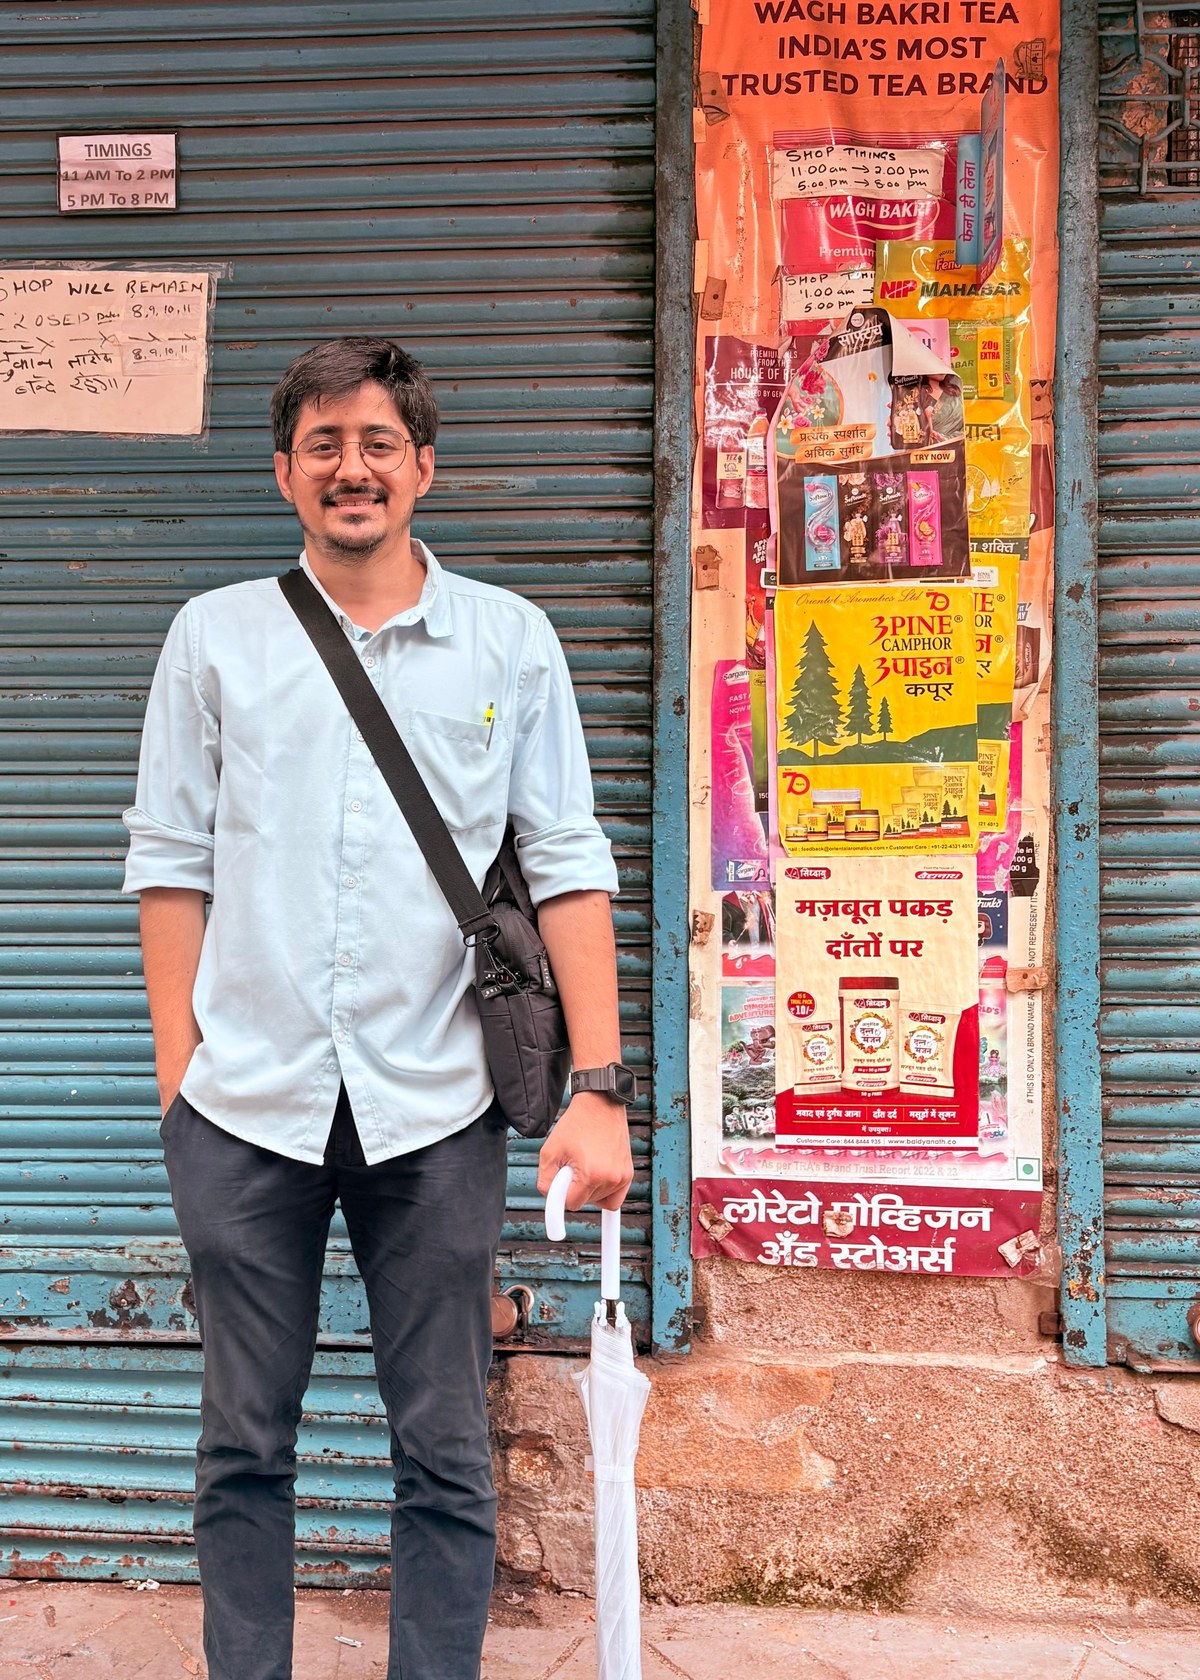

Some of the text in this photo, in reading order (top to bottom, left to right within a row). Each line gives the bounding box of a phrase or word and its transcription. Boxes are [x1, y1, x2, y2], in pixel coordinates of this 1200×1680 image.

[755, 0, 1020, 25] WAGH BAKRI TEA
[897, 36, 987, 61] MOST
[722, 69, 859, 97] TRUSTED
[868, 73, 928, 97] TEA
[84, 143, 152, 158] TIMINGS
[786, 146, 835, 162] SHOP
[62, 169, 175, 181] 11 AM To 2 PM
[875, 166, 905, 175] 2.00
[909, 167, 930, 178] pm
[830, 179, 848, 188] pm
[907, 179, 927, 190] pm
[67, 192, 169, 207] 5 PM To 8 PM
[830, 202, 875, 219] WAGH
[785, 274, 829, 286] SHOP
[68, 282, 115, 296] WILL
[126, 279, 204, 298] REMAIN
[880, 280, 1022, 299] NIP MAHABAR
[804, 300, 854, 313] 5.00 pm
[0, 312, 90, 330] LOSED
[982, 341, 998, 350] 20g
[980, 351, 1000, 360] EXTRA
[731, 367, 764, 379] HOUSE
[768, 368, 780, 379] OF
[882, 637, 952, 652] CAMPHOR
[729, 693, 747, 702] FAST
[905, 682, 954, 701] कपूर
[730, 706, 746, 714] NOW
[795, 900, 953, 924] मज़बूत पकड़
[1029, 904, 1037, 946] REPRESENT
[825, 931, 924, 960] दाँतों पर
[1027, 1023, 1035, 1047] BRAND
[844, 1110, 861, 1118] आना
[887, 1108, 897, 1119] दर्द
[938, 1111, 956, 1120] सूजन
[888, 1138, 957, 1146] www.baidyanath.co
[776, 1162, 791, 1171] per
[824, 1163, 851, 1172] Brand
[854, 1163, 878, 1173] Trust
[914, 1167, 935, 1175] 2022
[722, 1189, 823, 1225] लोरेटो
[829, 1235, 956, 1273] स्टोअर्स
